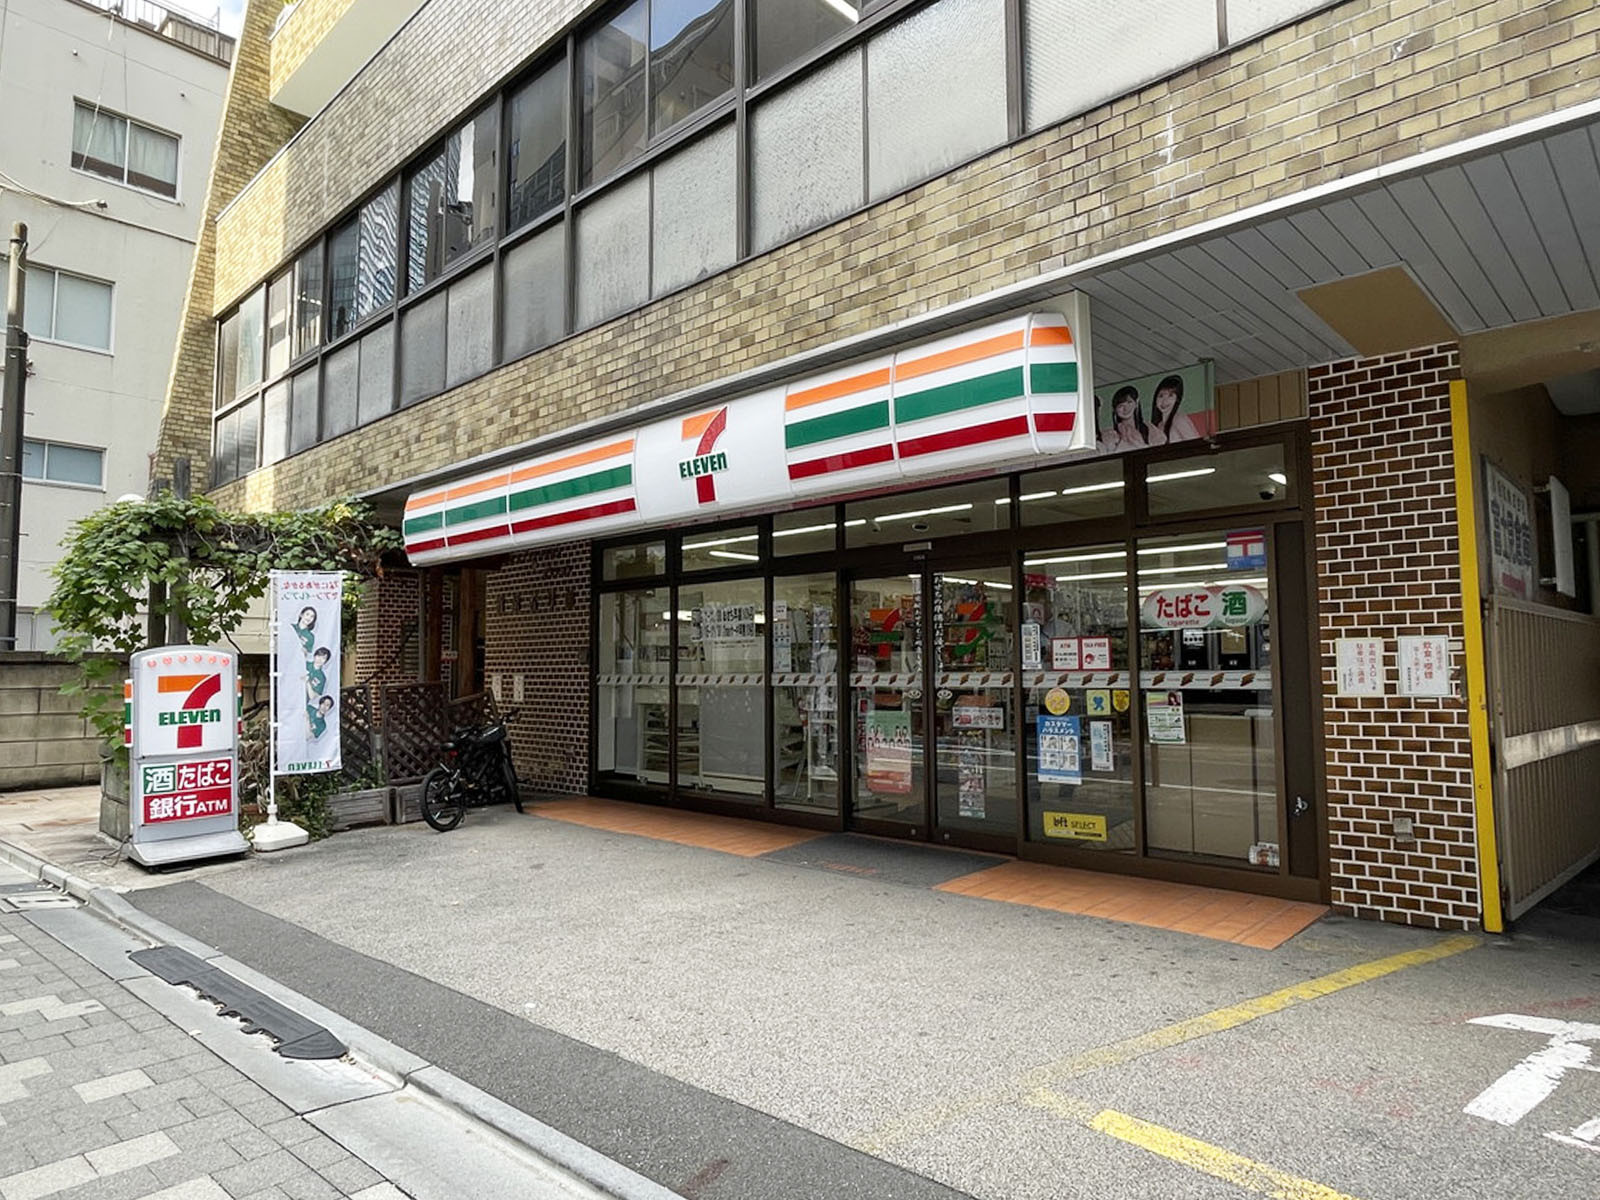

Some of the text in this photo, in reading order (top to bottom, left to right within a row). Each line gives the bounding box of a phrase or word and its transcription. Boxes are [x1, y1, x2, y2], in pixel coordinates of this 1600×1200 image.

[1156, 591, 1247, 619] たばこ 酒
[146, 762, 231, 793] 酒 たばこ
